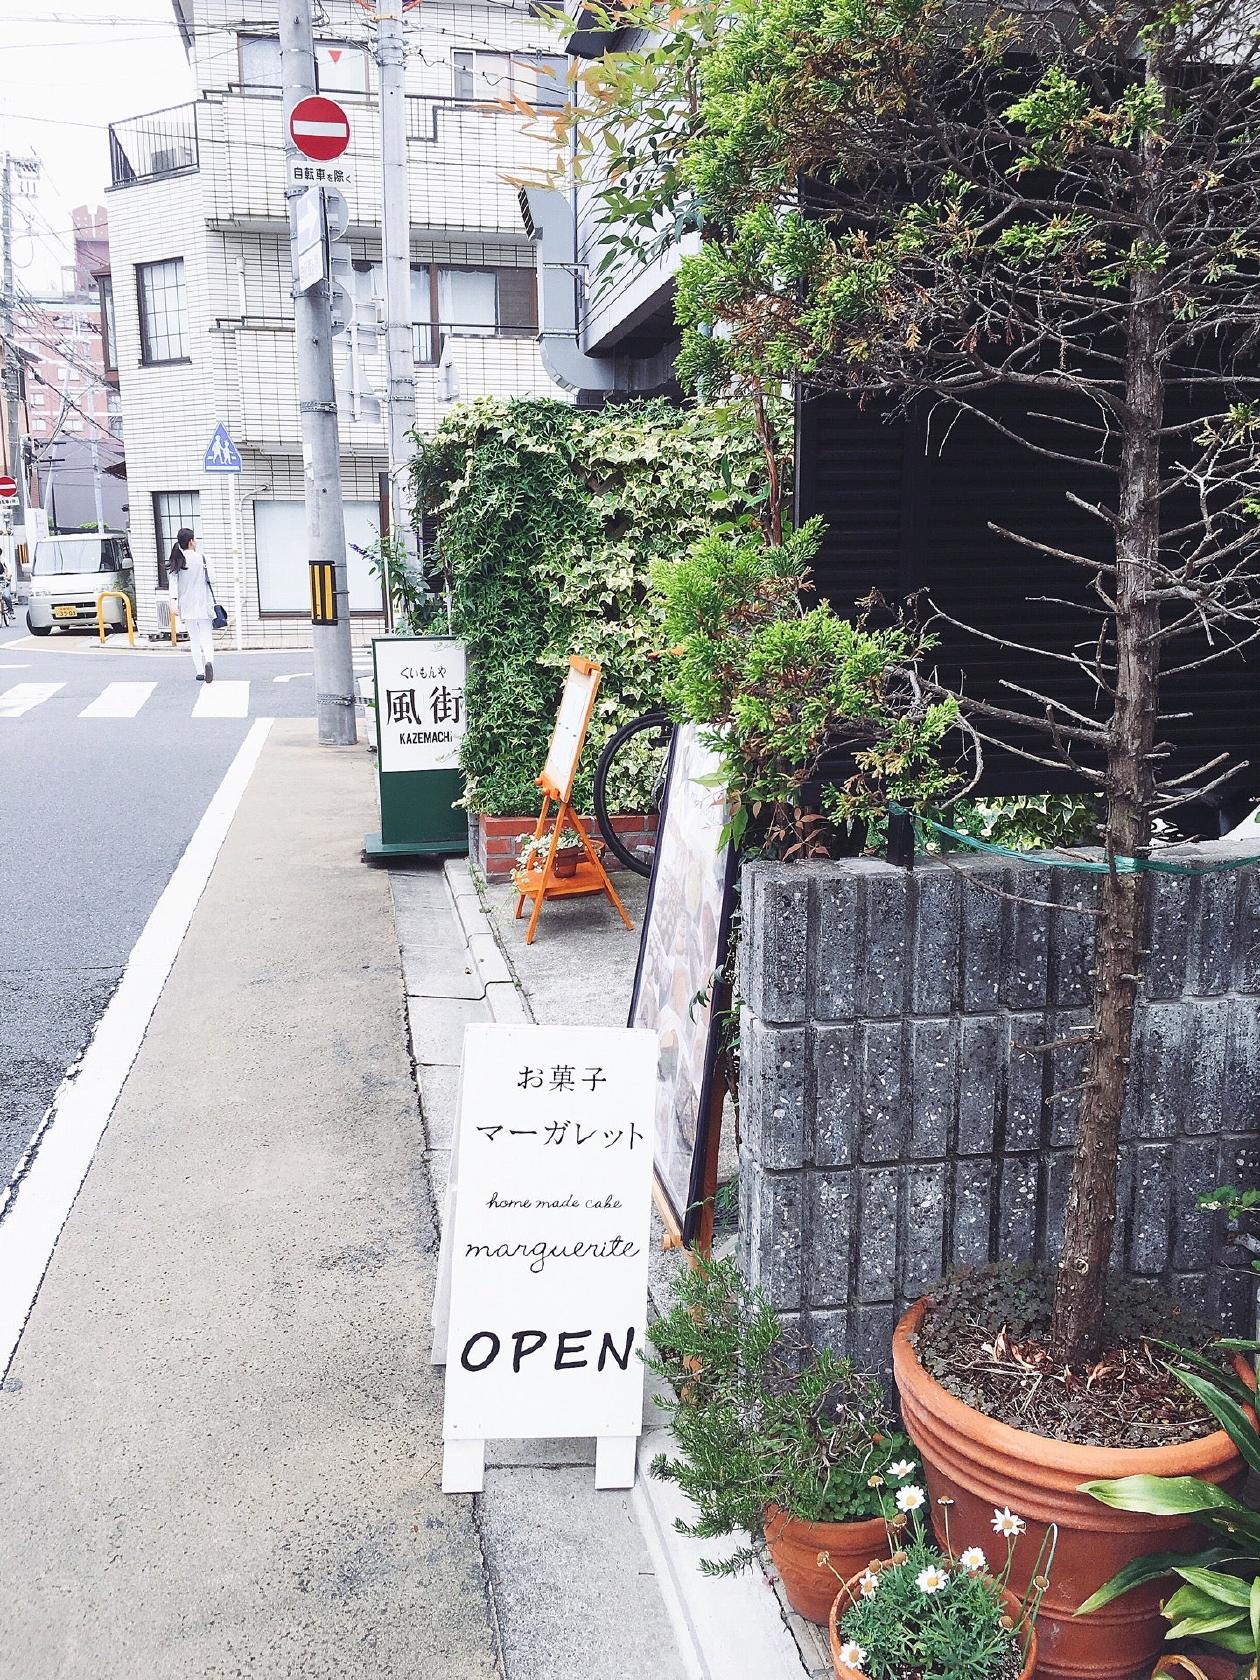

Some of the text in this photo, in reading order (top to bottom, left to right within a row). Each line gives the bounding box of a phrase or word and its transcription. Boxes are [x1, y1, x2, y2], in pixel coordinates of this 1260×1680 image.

[294, 166, 352, 183] 自転車を除く
[400, 665, 447, 680] くいもんや
[386, 685, 464, 726] 風街
[517, 1064, 607, 1092] お菓子
[476, 1119, 644, 1150] マーガレット
[486, 1191, 532, 1209] home
[535, 1193, 580, 1209] made
[465, 1234, 641, 1274] marguerite
[460, 1326, 636, 1374] OPEN
